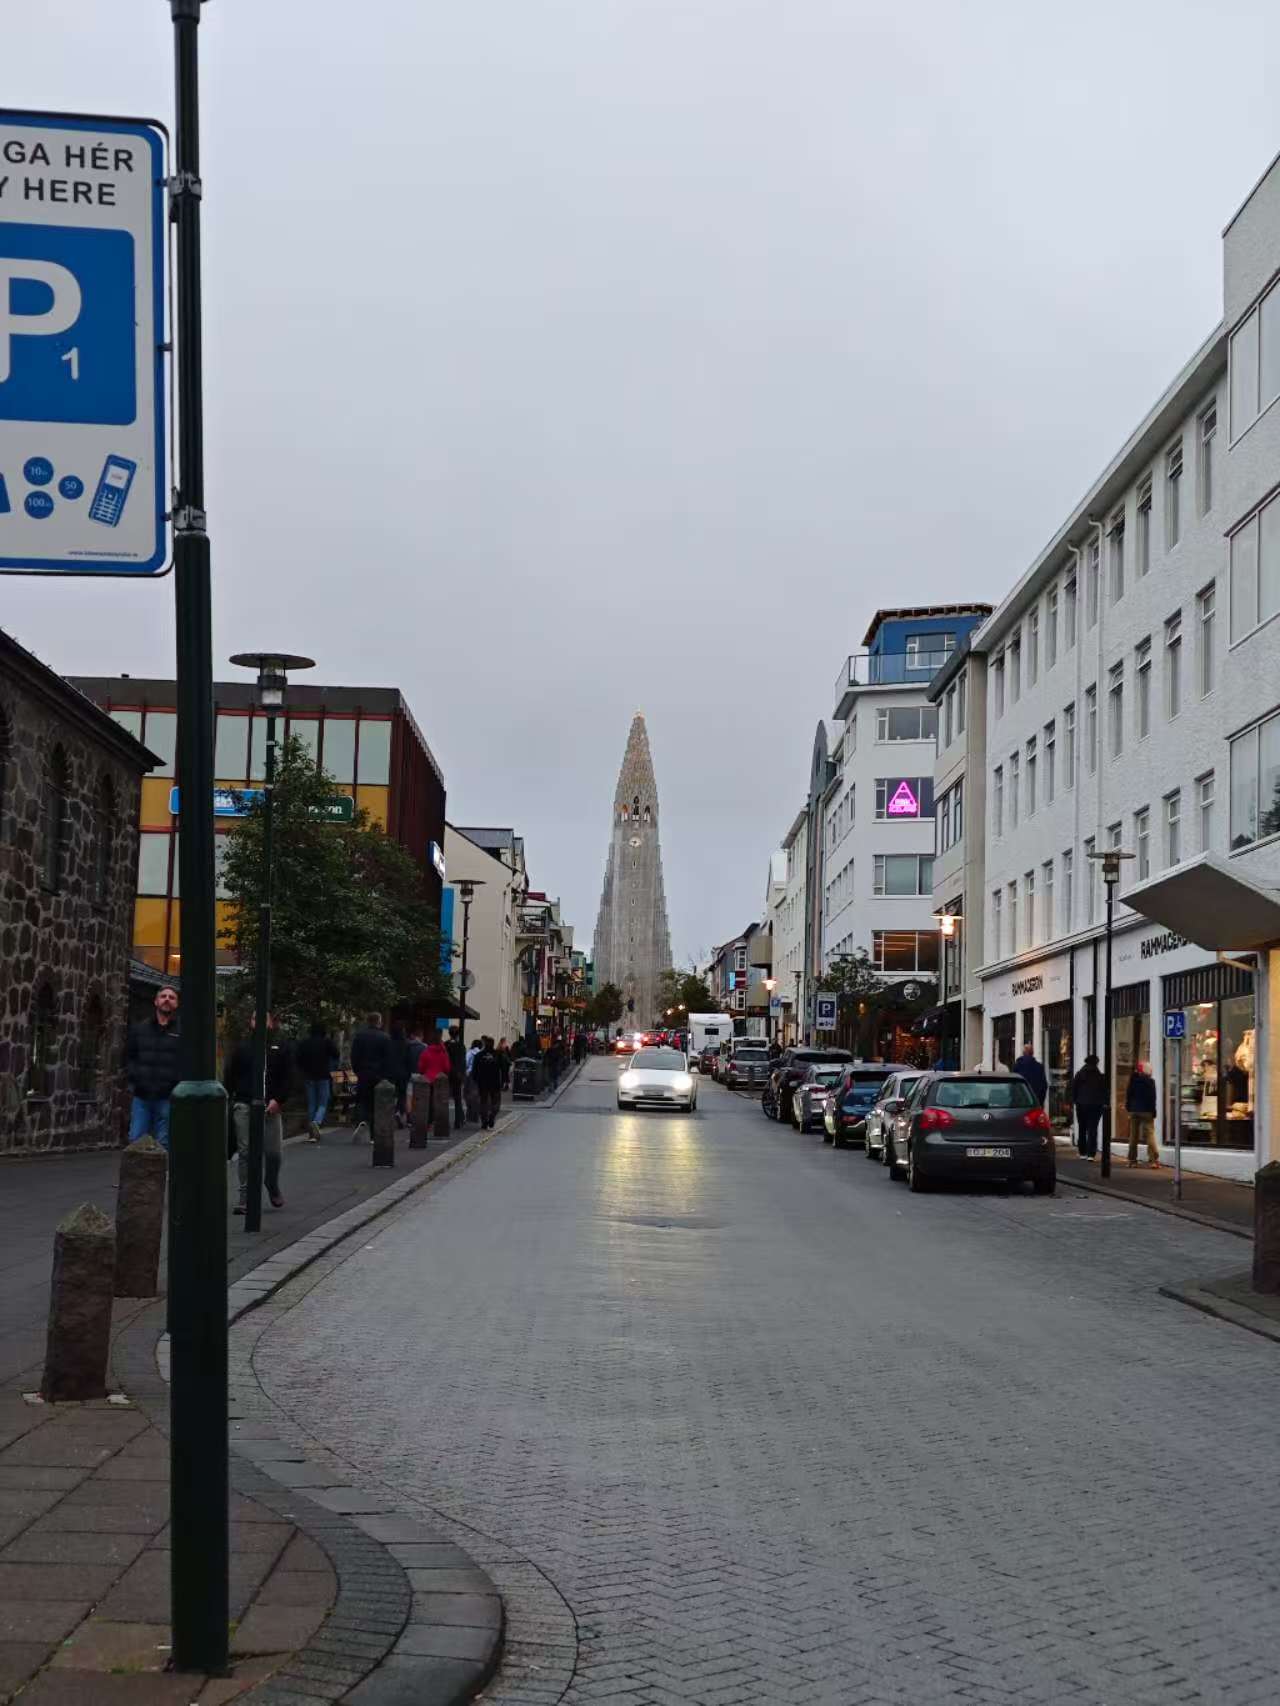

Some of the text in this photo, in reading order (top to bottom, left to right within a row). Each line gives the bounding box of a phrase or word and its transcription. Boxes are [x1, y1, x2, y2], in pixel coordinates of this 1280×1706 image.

[65, 141, 134, 173] HÉR
[24, 176, 116, 207] HERE
[0, 257, 82, 384] P
[61, 346, 79, 381] 1
[821, 1002, 831, 1015] P
[1166, 1015, 1175, 1034] P
